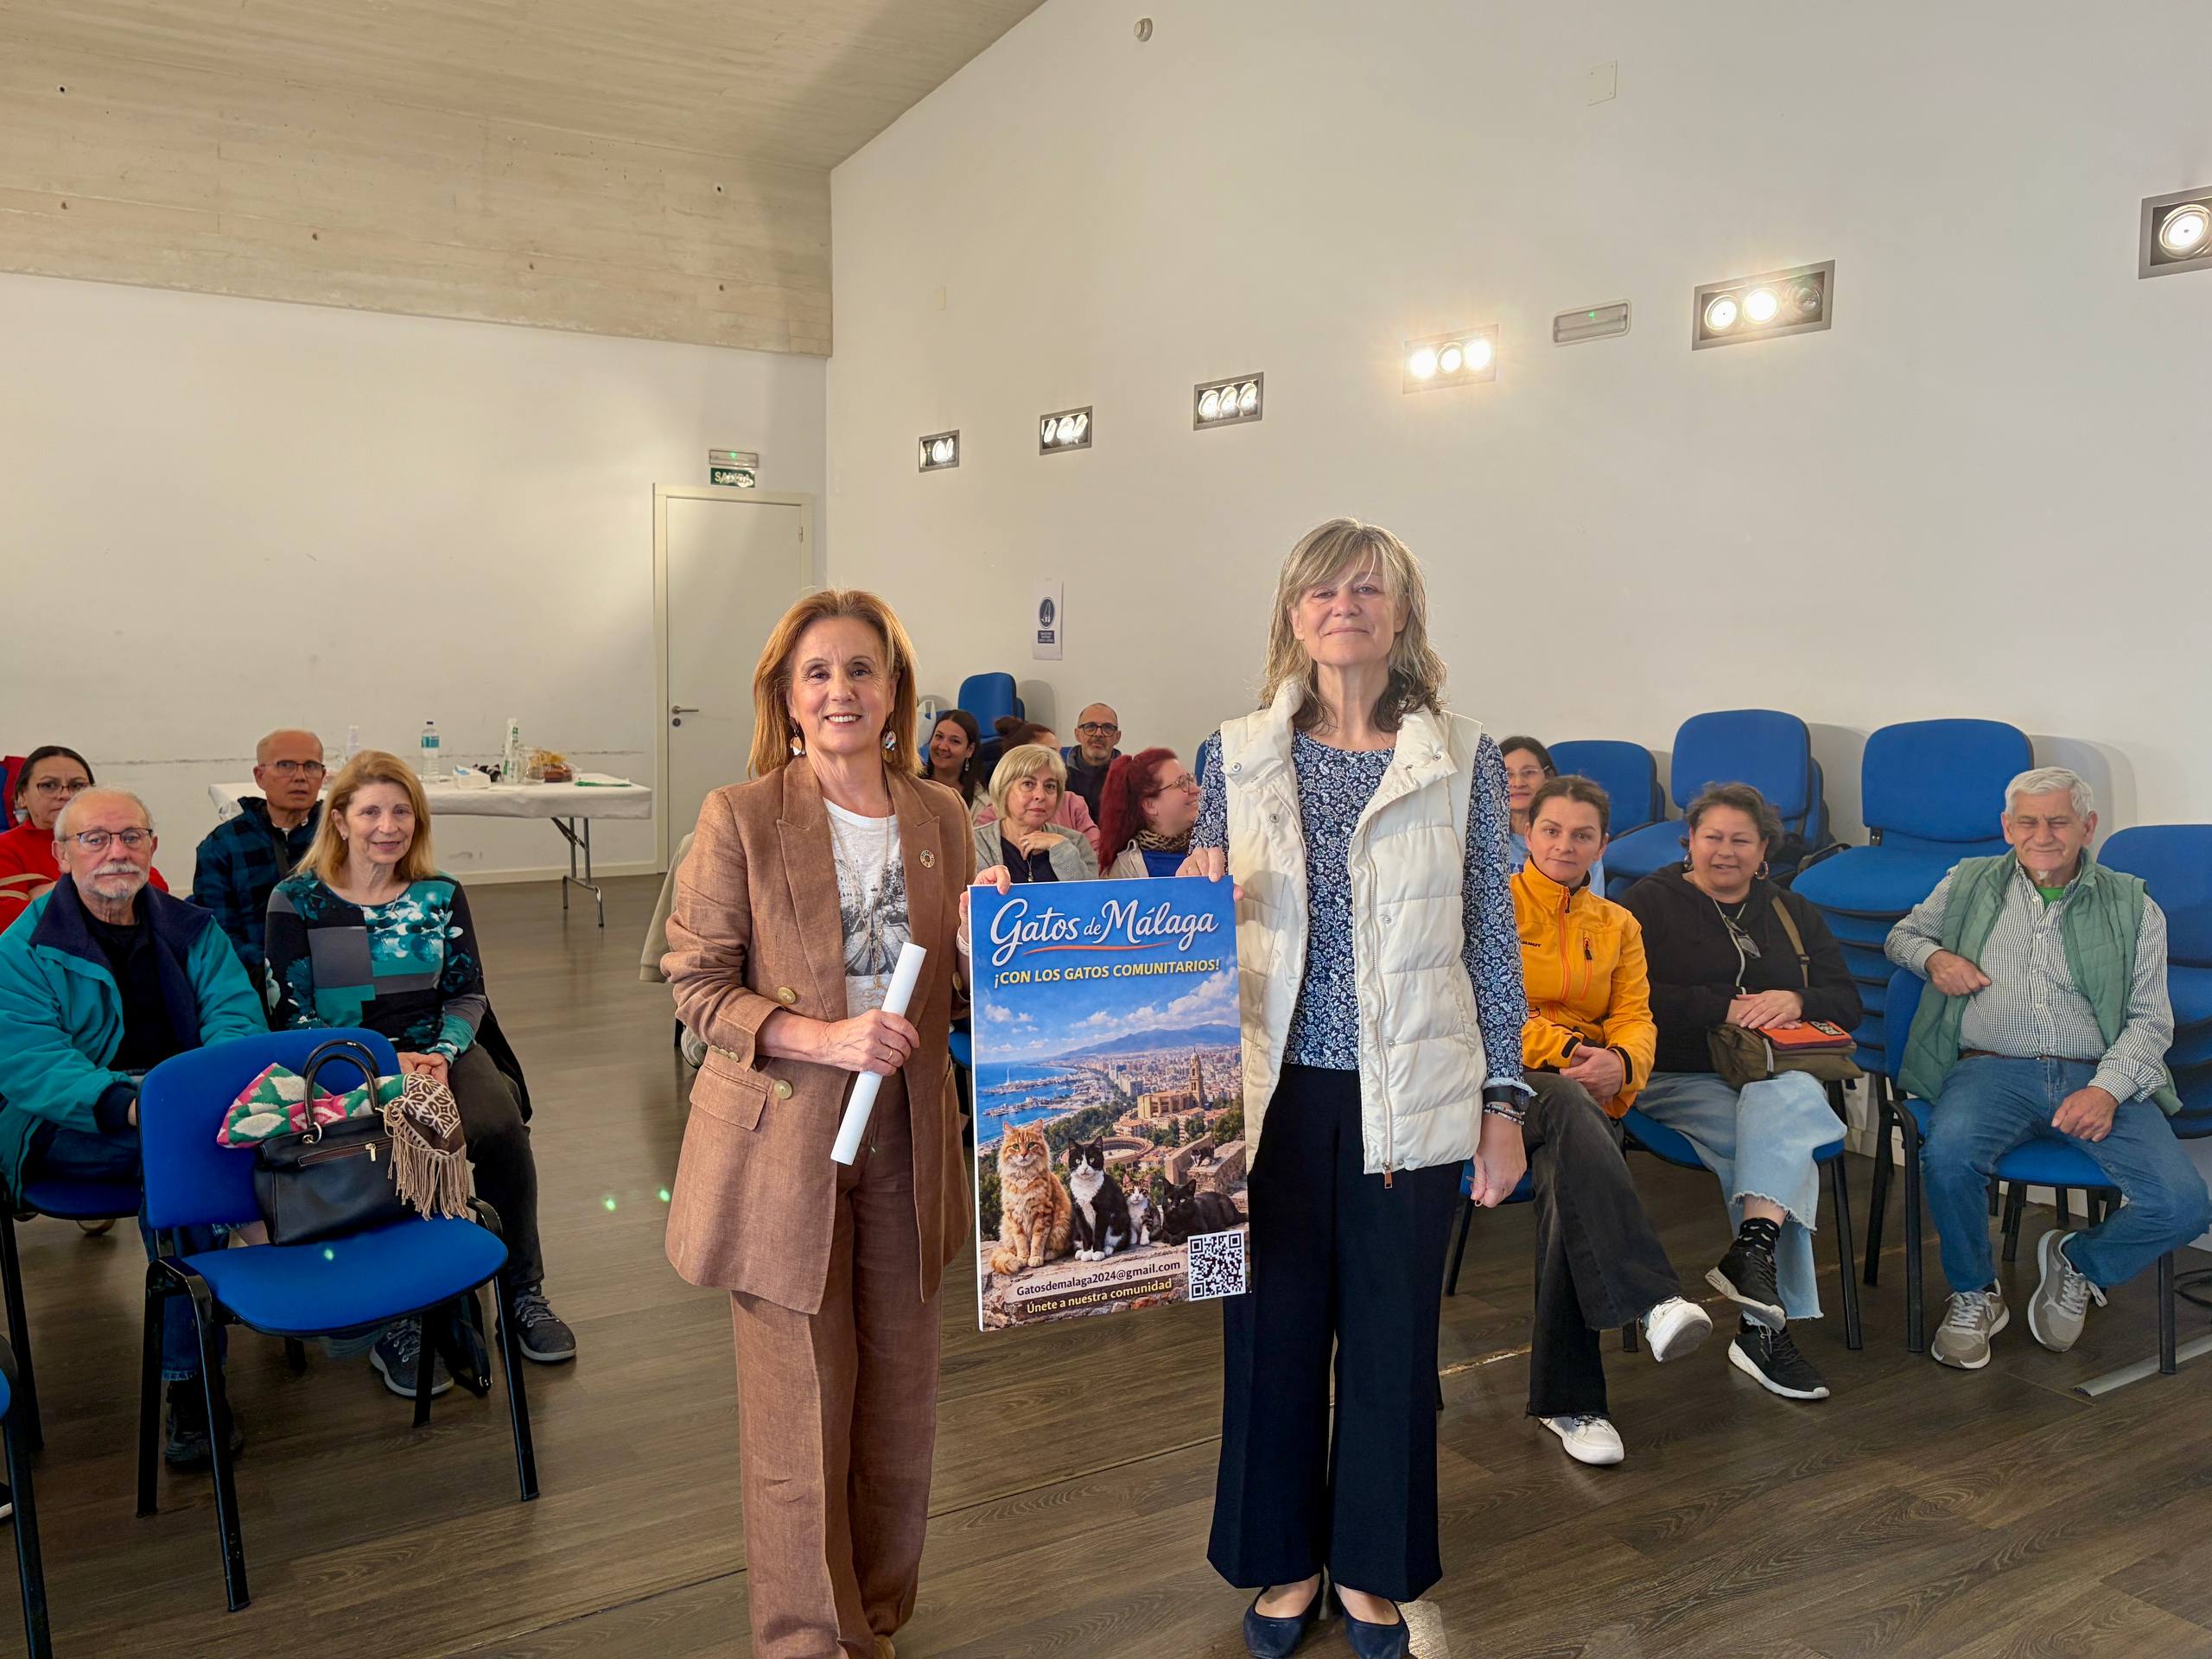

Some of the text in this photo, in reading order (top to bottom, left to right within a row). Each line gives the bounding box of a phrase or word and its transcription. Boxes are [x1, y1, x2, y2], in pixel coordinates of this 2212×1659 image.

[990, 898, 1219, 967] Gatos de Málaga
[995, 958, 1220, 988] ¡CON LOS GATOS COMUNITARIOS!
[1016, 1262, 1180, 1296] Gatosdemalaga2024@gmail.com
[1027, 1277, 1173, 1313] Únete a nuestra comunidad
